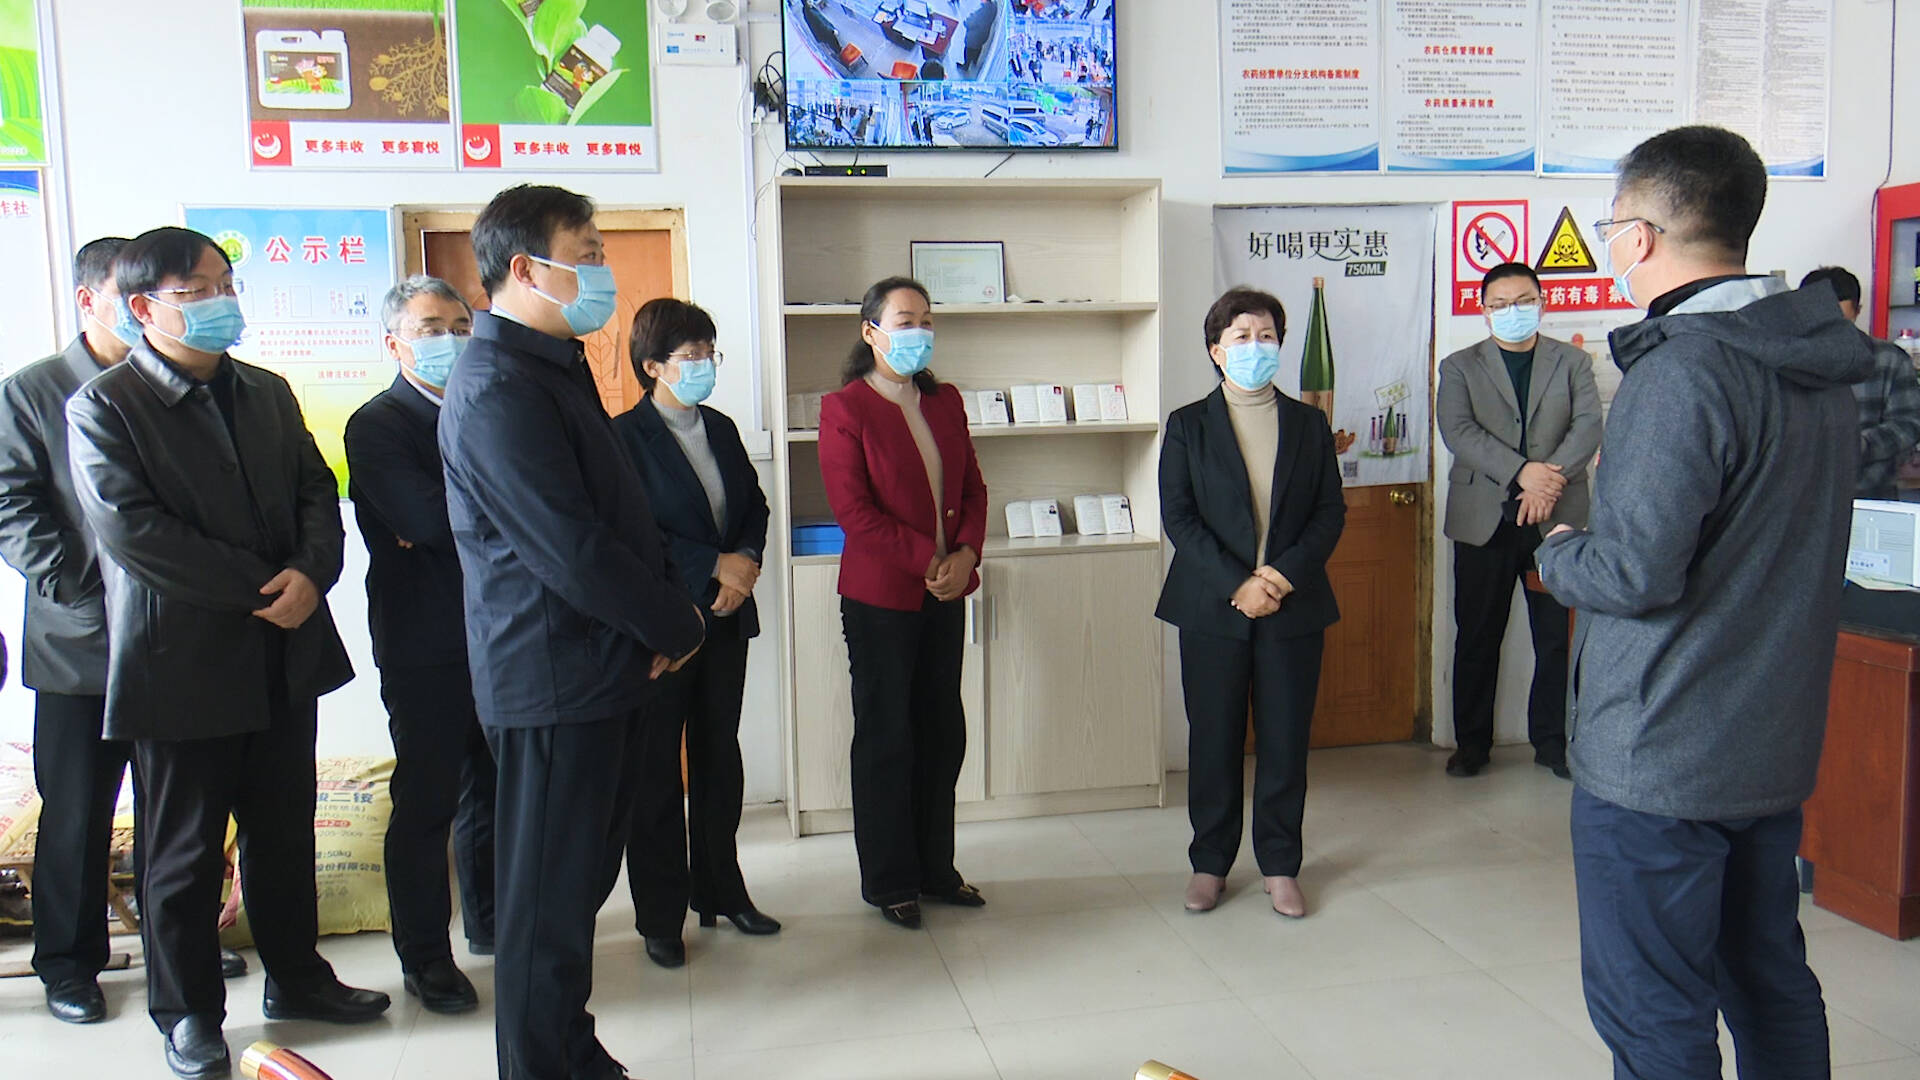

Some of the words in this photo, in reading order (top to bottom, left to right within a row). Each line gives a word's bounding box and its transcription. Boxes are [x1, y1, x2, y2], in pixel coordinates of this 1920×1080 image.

[1424, 46, 1494, 55] 农药仓库管理制度
[1242, 69, 1360, 79] 农药经营单位分支机构备案制度
[305, 140, 364, 153] 更多丰收
[382, 140, 440, 154] 更多喜悦
[514, 142, 571, 155] 更多丰收
[587, 143, 642, 156] 更多喜悦
[265, 237, 366, 264] 公示栏
[1248, 227, 1389, 261] 好喝更实惠
[1347, 263, 1384, 276] 750ML
